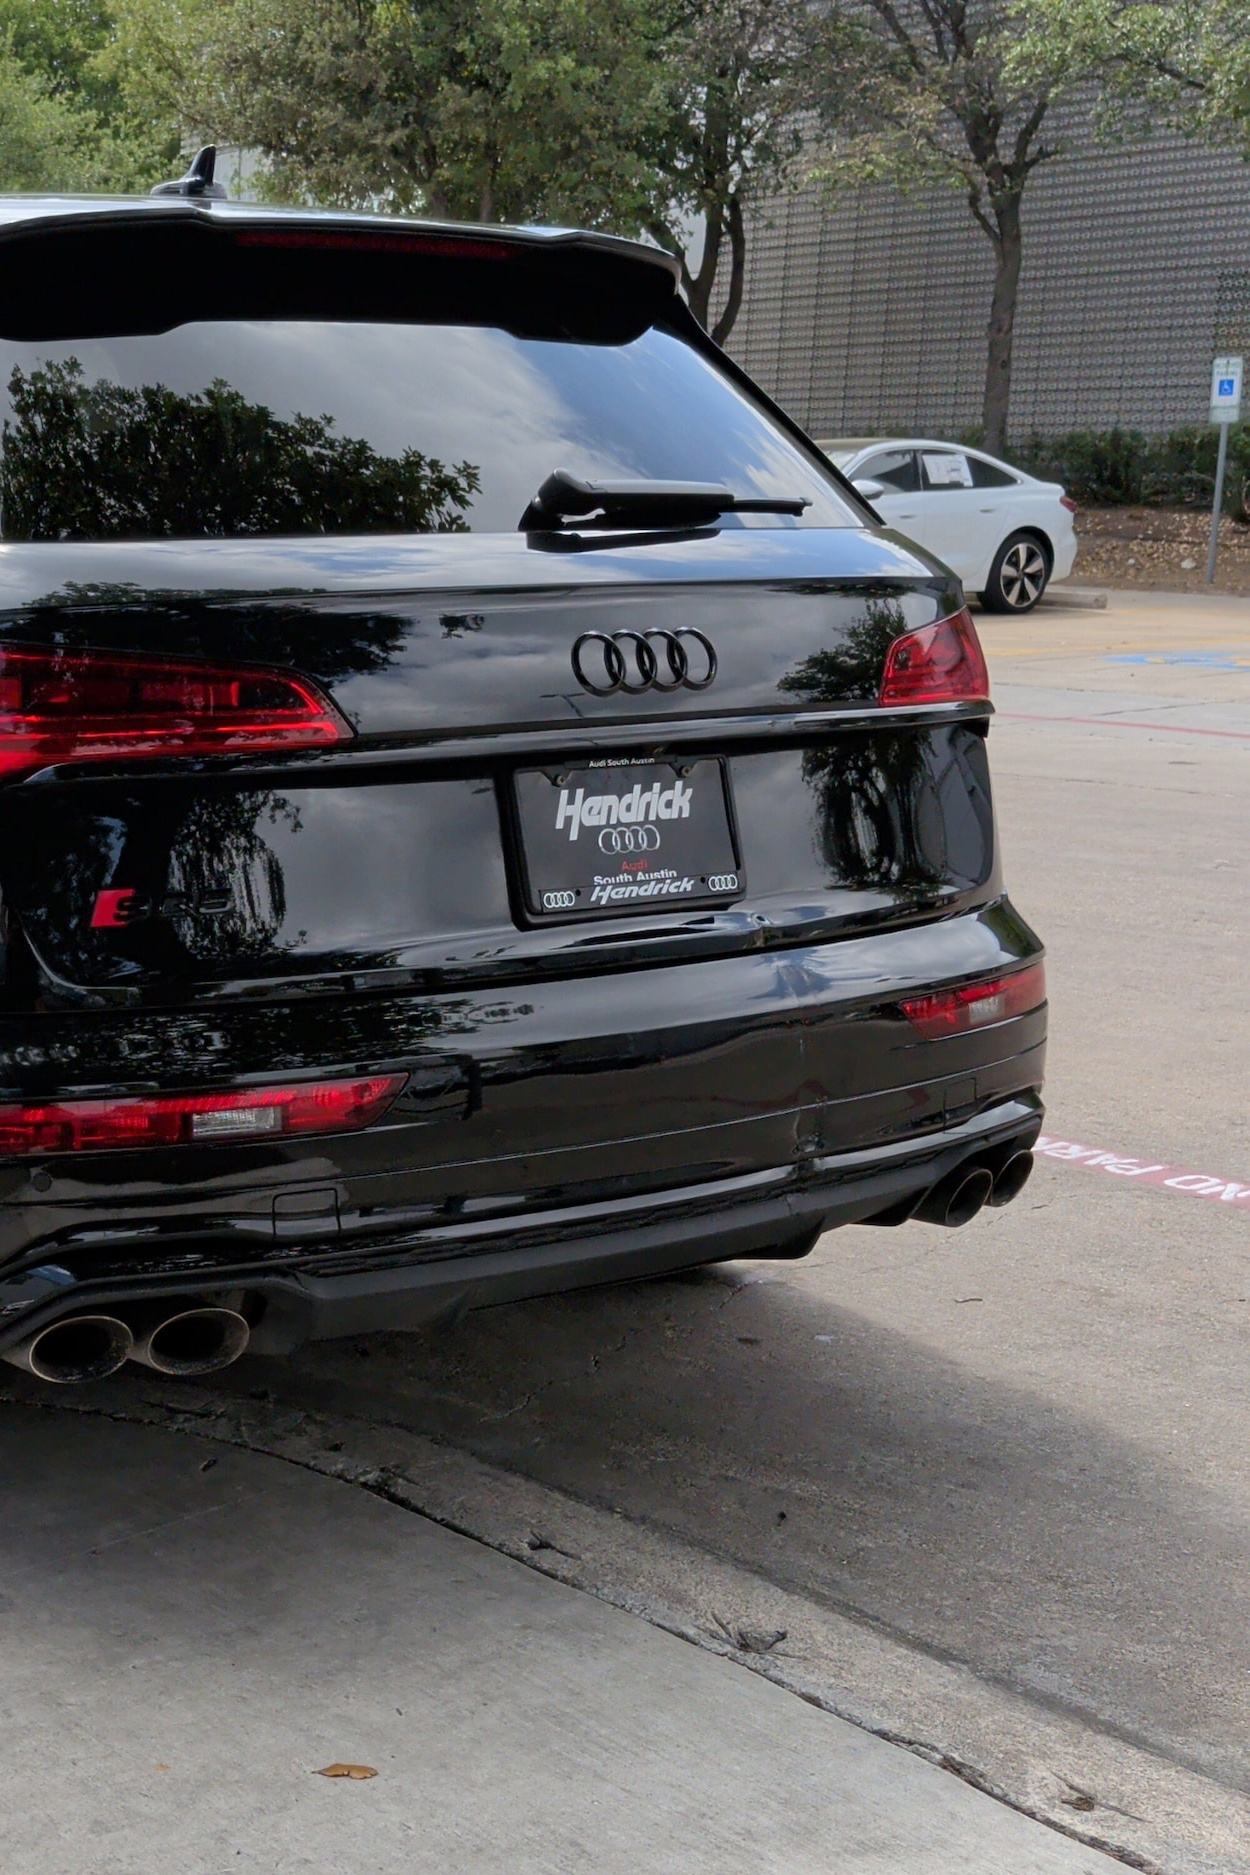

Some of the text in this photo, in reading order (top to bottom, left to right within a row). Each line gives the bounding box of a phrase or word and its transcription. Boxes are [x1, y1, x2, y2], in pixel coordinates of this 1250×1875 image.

[588, 756, 655, 768] Audi South Austin
[555, 780, 693, 841] Hendrick
[621, 859, 648, 871] Audi
[593, 868, 677, 885] South Austin
[590, 877, 694, 905] Hendrick
[1163, 1173, 1250, 1201] NO
